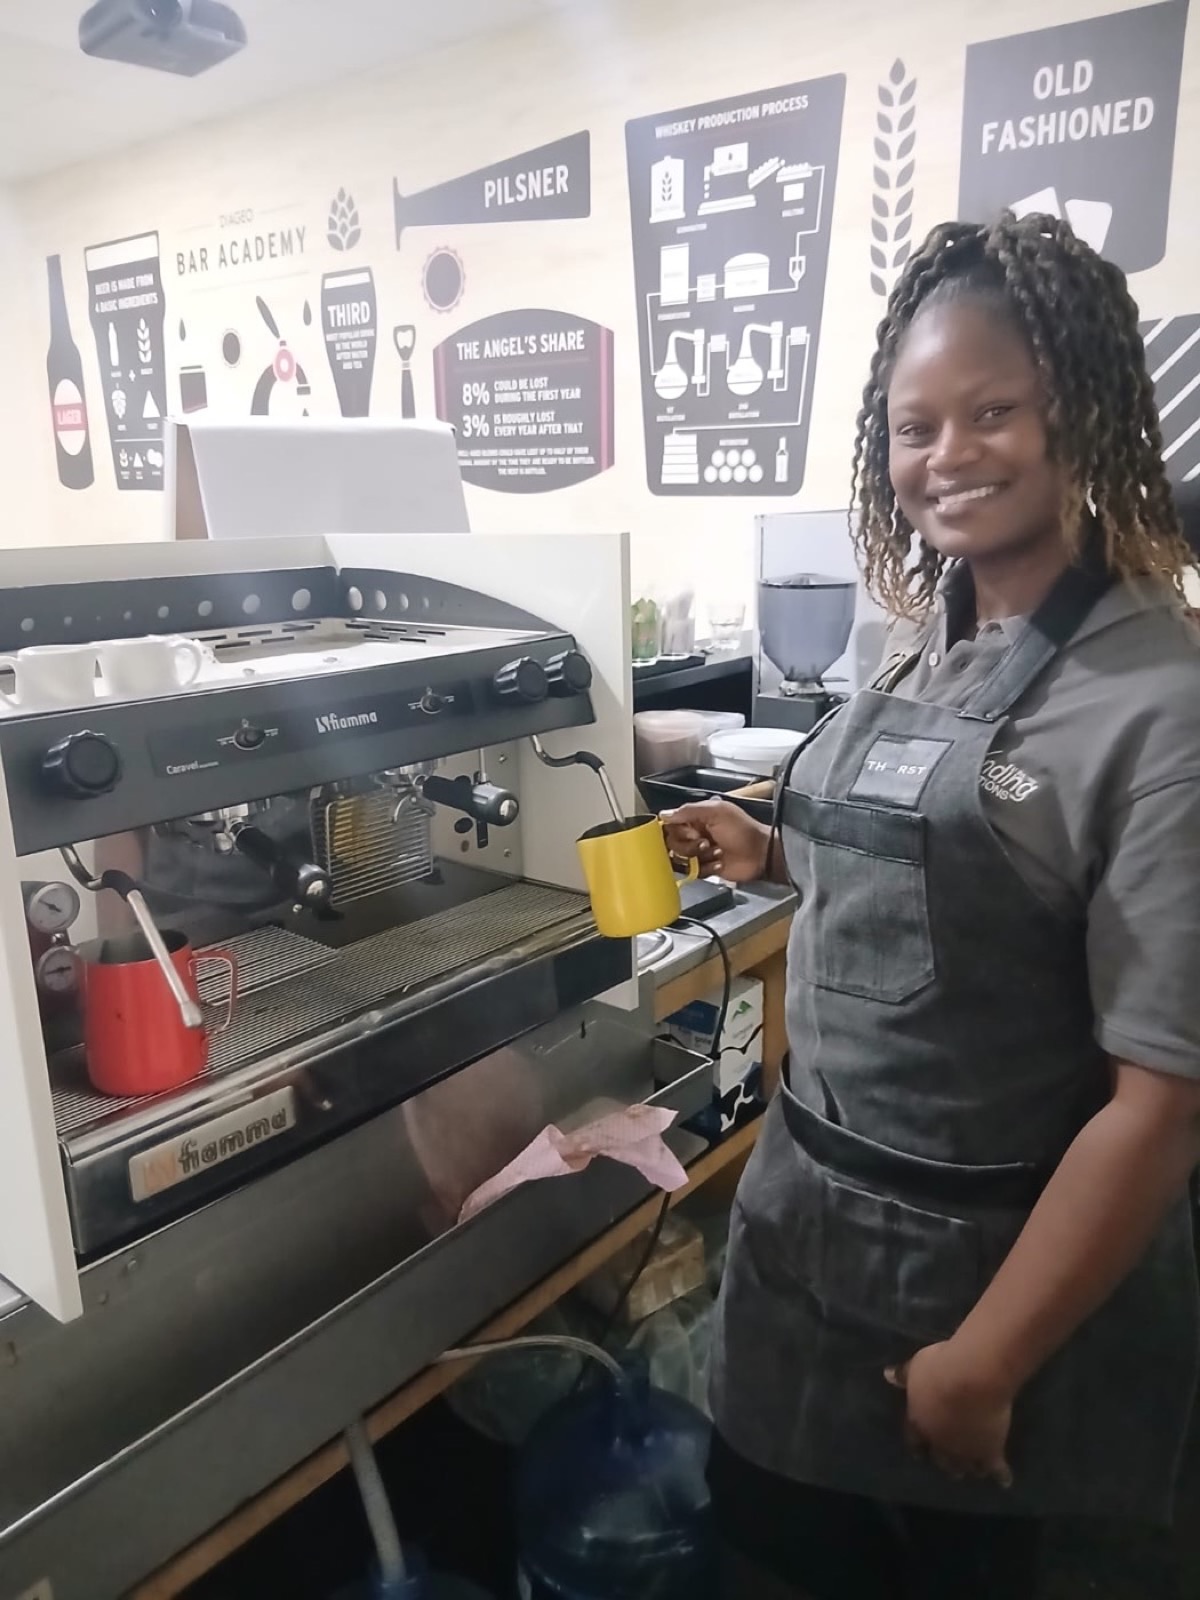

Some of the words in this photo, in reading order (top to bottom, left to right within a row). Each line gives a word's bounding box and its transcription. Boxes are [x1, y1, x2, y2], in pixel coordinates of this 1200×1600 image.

[1033, 59, 1093, 100] OLD
[655, 118, 697, 138] WHISKEY
[698, 105, 760, 130] PRODUCTION
[761, 95, 808, 117] PROCESS
[981, 96, 1154, 154] FASHIONED
[484, 164, 569, 208] PILSNER
[176, 247, 208, 276] BAR
[218, 225, 306, 268] ACADEMY
[327, 301, 370, 327] THIRD
[456, 341, 480, 360] THE
[483, 335, 537, 359] ANGEL'S
[540, 329, 585, 353] SHARE
[462, 382, 490, 406] 8%
[494, 379, 517, 391] COULD
[518, 378, 528, 390] BE
[529, 377, 548, 389] LOST
[522, 390, 536, 402] THE
[537, 389, 559, 401] FIRST
[560, 388, 581, 400] YEAR
[462, 414, 490, 437] 3%
[494, 425, 516, 437] EVERY
[518, 424, 537, 436] YEAR
[539, 423, 562, 435] AFTER
[563, 422, 583, 434] THAT
[536, 411, 555, 423] LOST
[328, 711, 378, 732] fiamma
[166, 760, 198, 774] Caravel
[982, 759, 1038, 802] nding
[178, 1108, 286, 1174] fiamma
